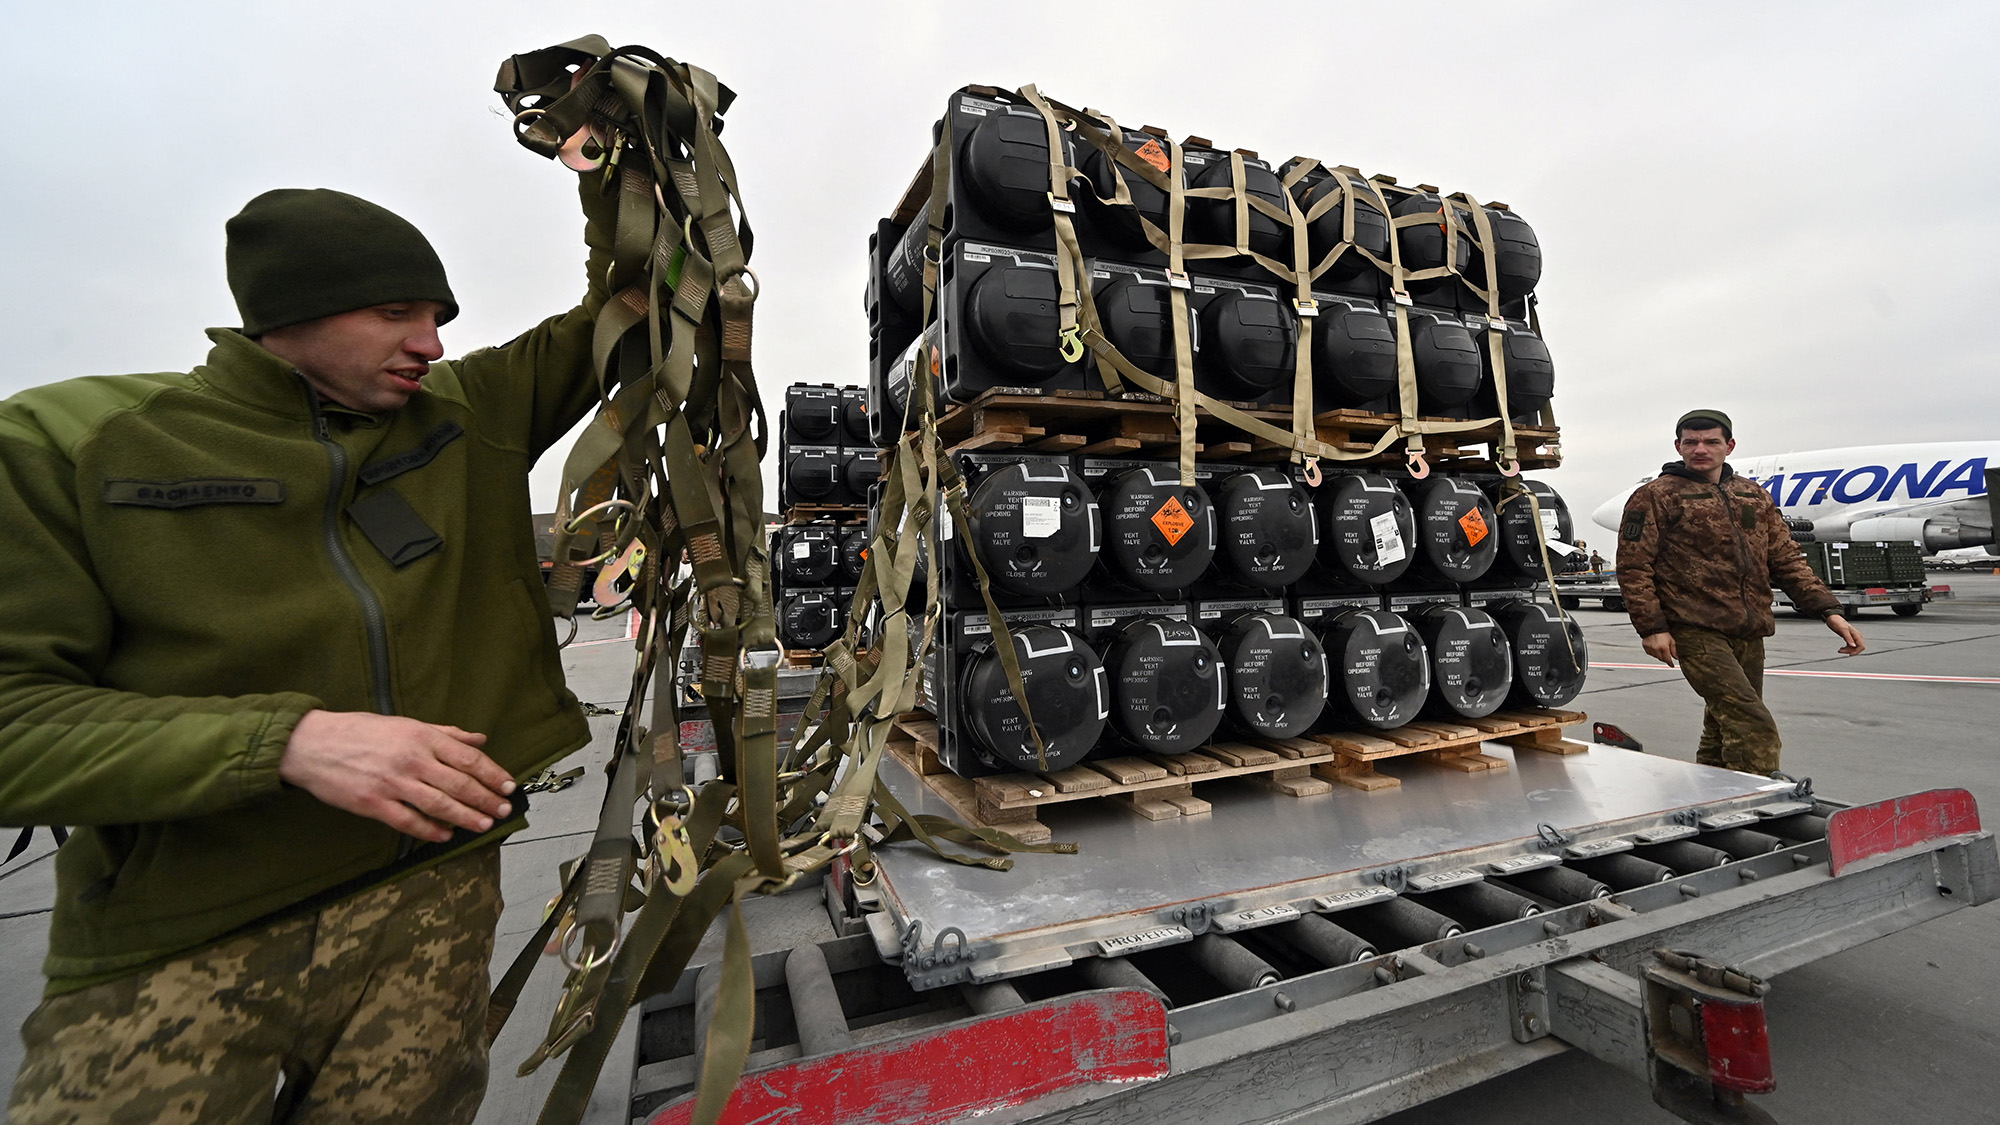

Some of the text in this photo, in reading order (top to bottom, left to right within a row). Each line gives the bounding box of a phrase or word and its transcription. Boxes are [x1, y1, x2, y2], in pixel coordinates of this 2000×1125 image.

[1753, 457, 1988, 508] ATIONA
[1104, 926, 1182, 948] PROPERTY
[1238, 912, 1256, 921] OF
[1261, 905, 1293, 916] U.S.
